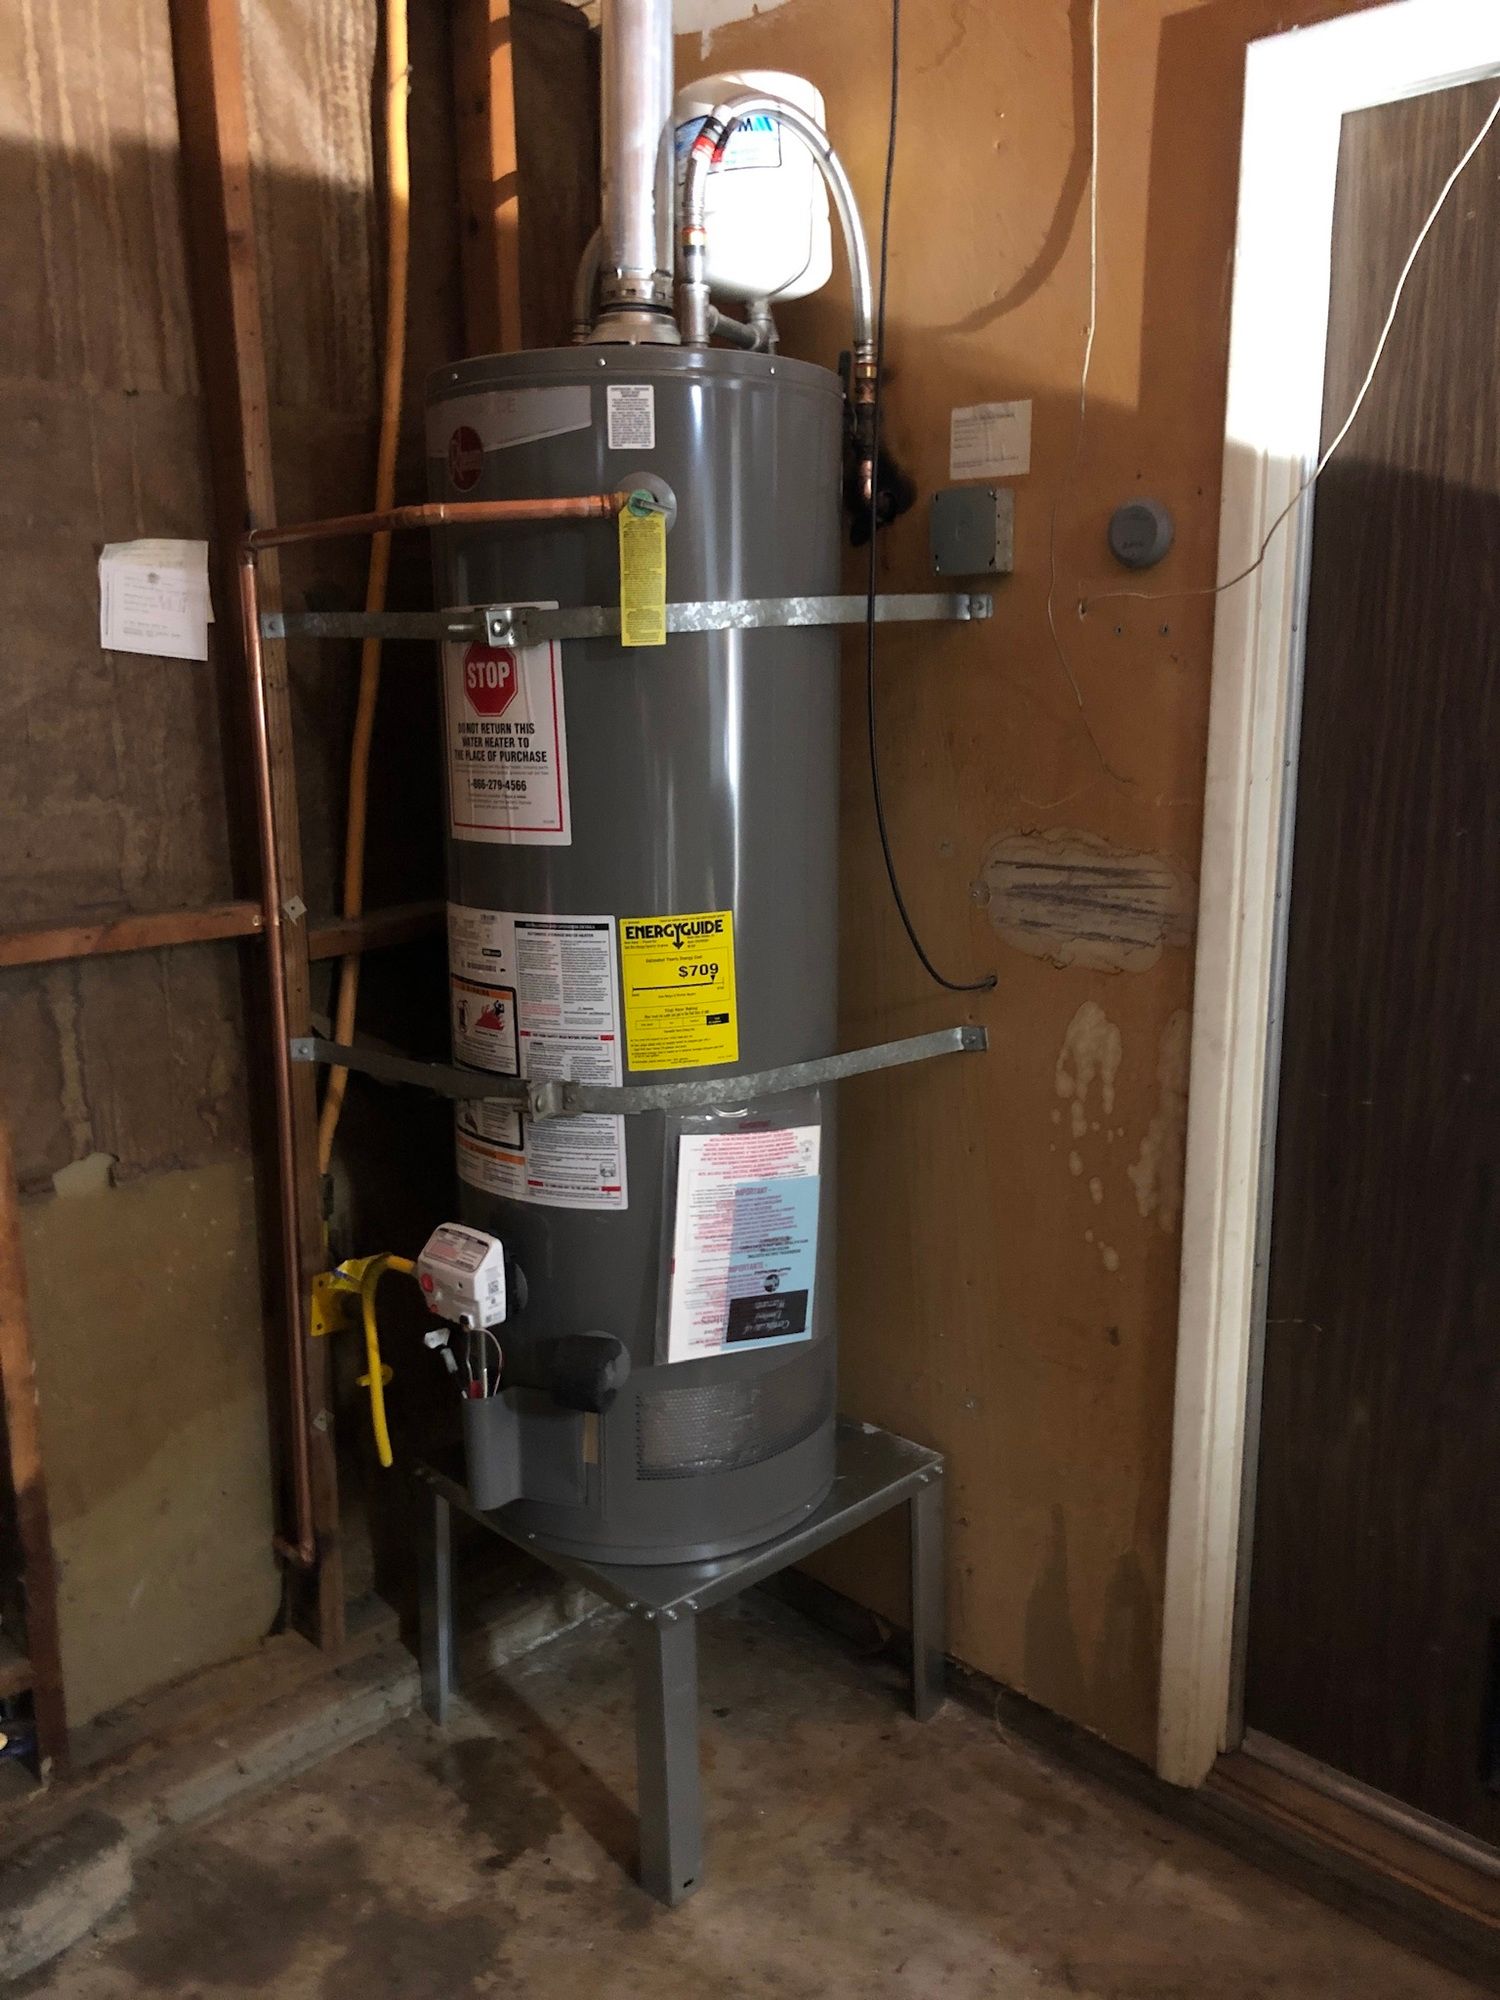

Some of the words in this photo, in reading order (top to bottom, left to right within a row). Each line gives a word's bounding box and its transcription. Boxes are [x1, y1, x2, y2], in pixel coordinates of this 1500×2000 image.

[467, 660, 511, 689] STOP
[458, 723, 466, 734] DO
[466, 723, 479, 734] NOT
[481, 723, 512, 734] RETURN
[515, 723, 535, 735] THIS
[462, 736, 483, 748] WATER
[485, 737, 515, 748] HEATER
[518, 737, 530, 748] TO
[454, 749, 464, 760] THE
[465, 750, 486, 761] PLACE
[488, 750, 497, 762] OF
[499, 751, 548, 763] PURCHASE
[467, 778, 527, 791] 1-866-279-4566
[625, 919, 724, 942] ENERGYGUIDE
[678, 963, 719, 978] $709
